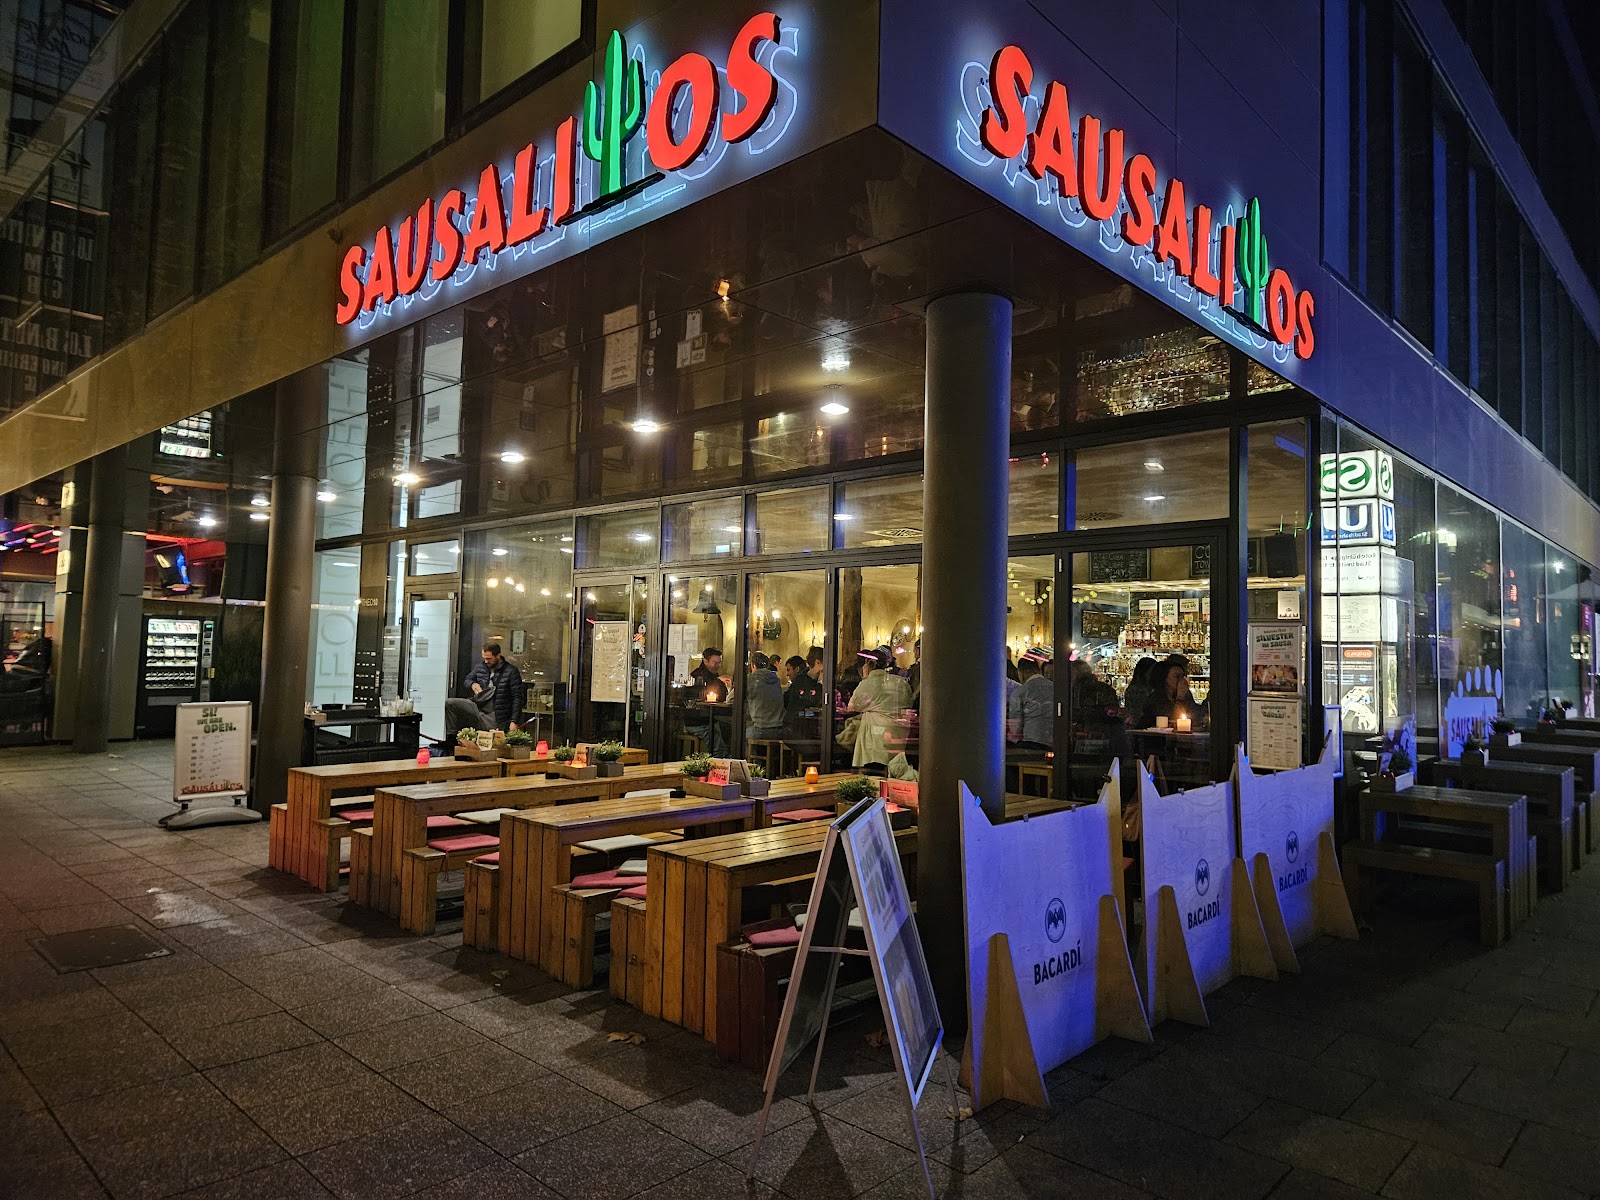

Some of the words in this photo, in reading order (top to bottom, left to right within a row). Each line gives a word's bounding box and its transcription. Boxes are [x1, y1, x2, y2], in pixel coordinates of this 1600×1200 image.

[1256, 632, 1294, 642] SILVESTER
[1279, 863, 1308, 892] BACARDÍ
[1187, 894, 1220, 929] BACARDÍ
[1034, 939, 1081, 985] BACARDÍ
